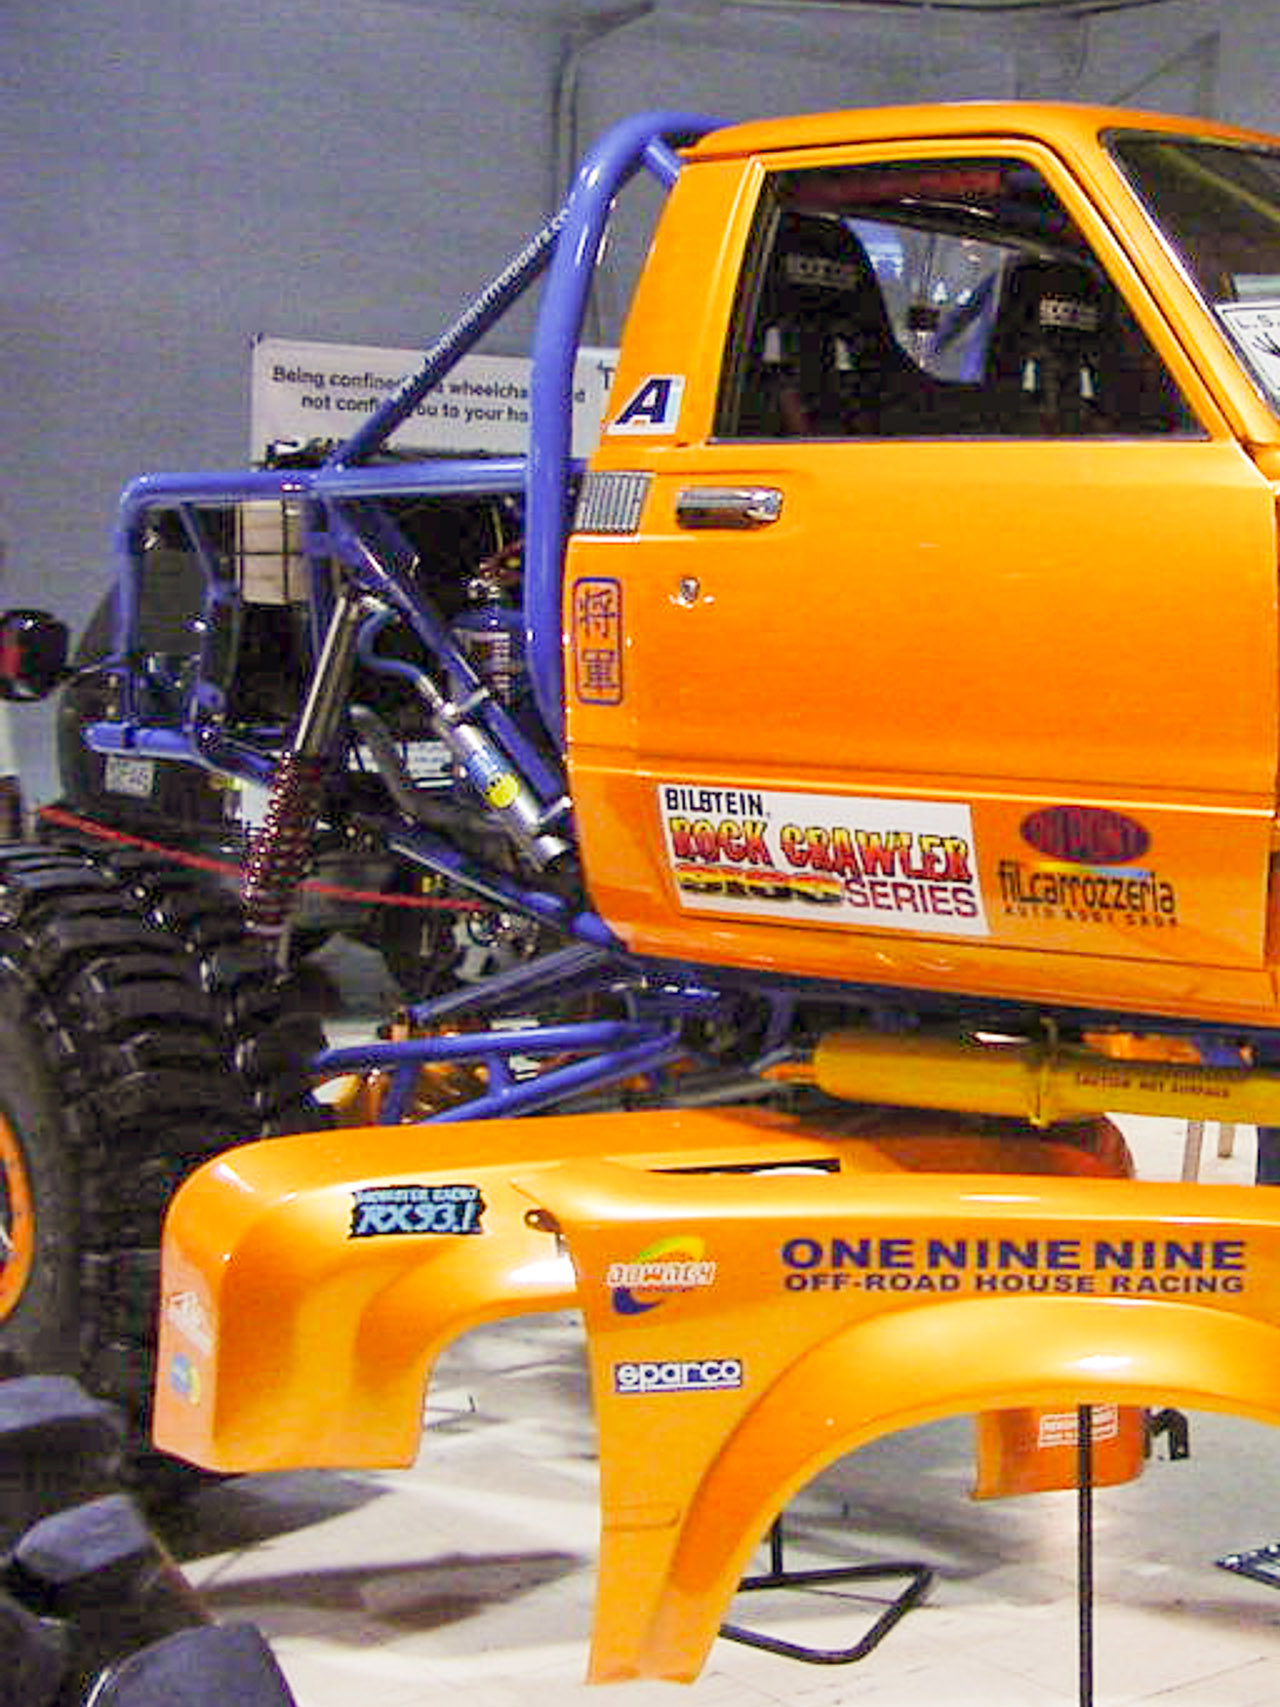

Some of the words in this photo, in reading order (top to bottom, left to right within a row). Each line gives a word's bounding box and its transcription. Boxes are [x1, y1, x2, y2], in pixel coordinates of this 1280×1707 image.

[272, 365, 325, 389] Being
[329, 371, 402, 391] confine
[301, 394, 331, 411] not
[442, 403, 459, 418] to
[464, 407, 505, 423] your
[664, 787, 765, 817] BILSTEIN
[668, 816, 774, 868] ROCK
[779, 823, 974, 885] CRAWLER
[843, 876, 979, 919] SERIES
[356, 1201, 477, 1233] RX93.1
[781, 1237, 914, 1271] ONE
[926, 1238, 1081, 1270] NINE
[1094, 1239, 1248, 1271] NINE
[784, 1274, 961, 1292] OFF-ROAD
[975, 1275, 1096, 1293] HOUSE
[1110, 1276, 1246, 1294] RACING
[617, 1360, 742, 1391] sparco
